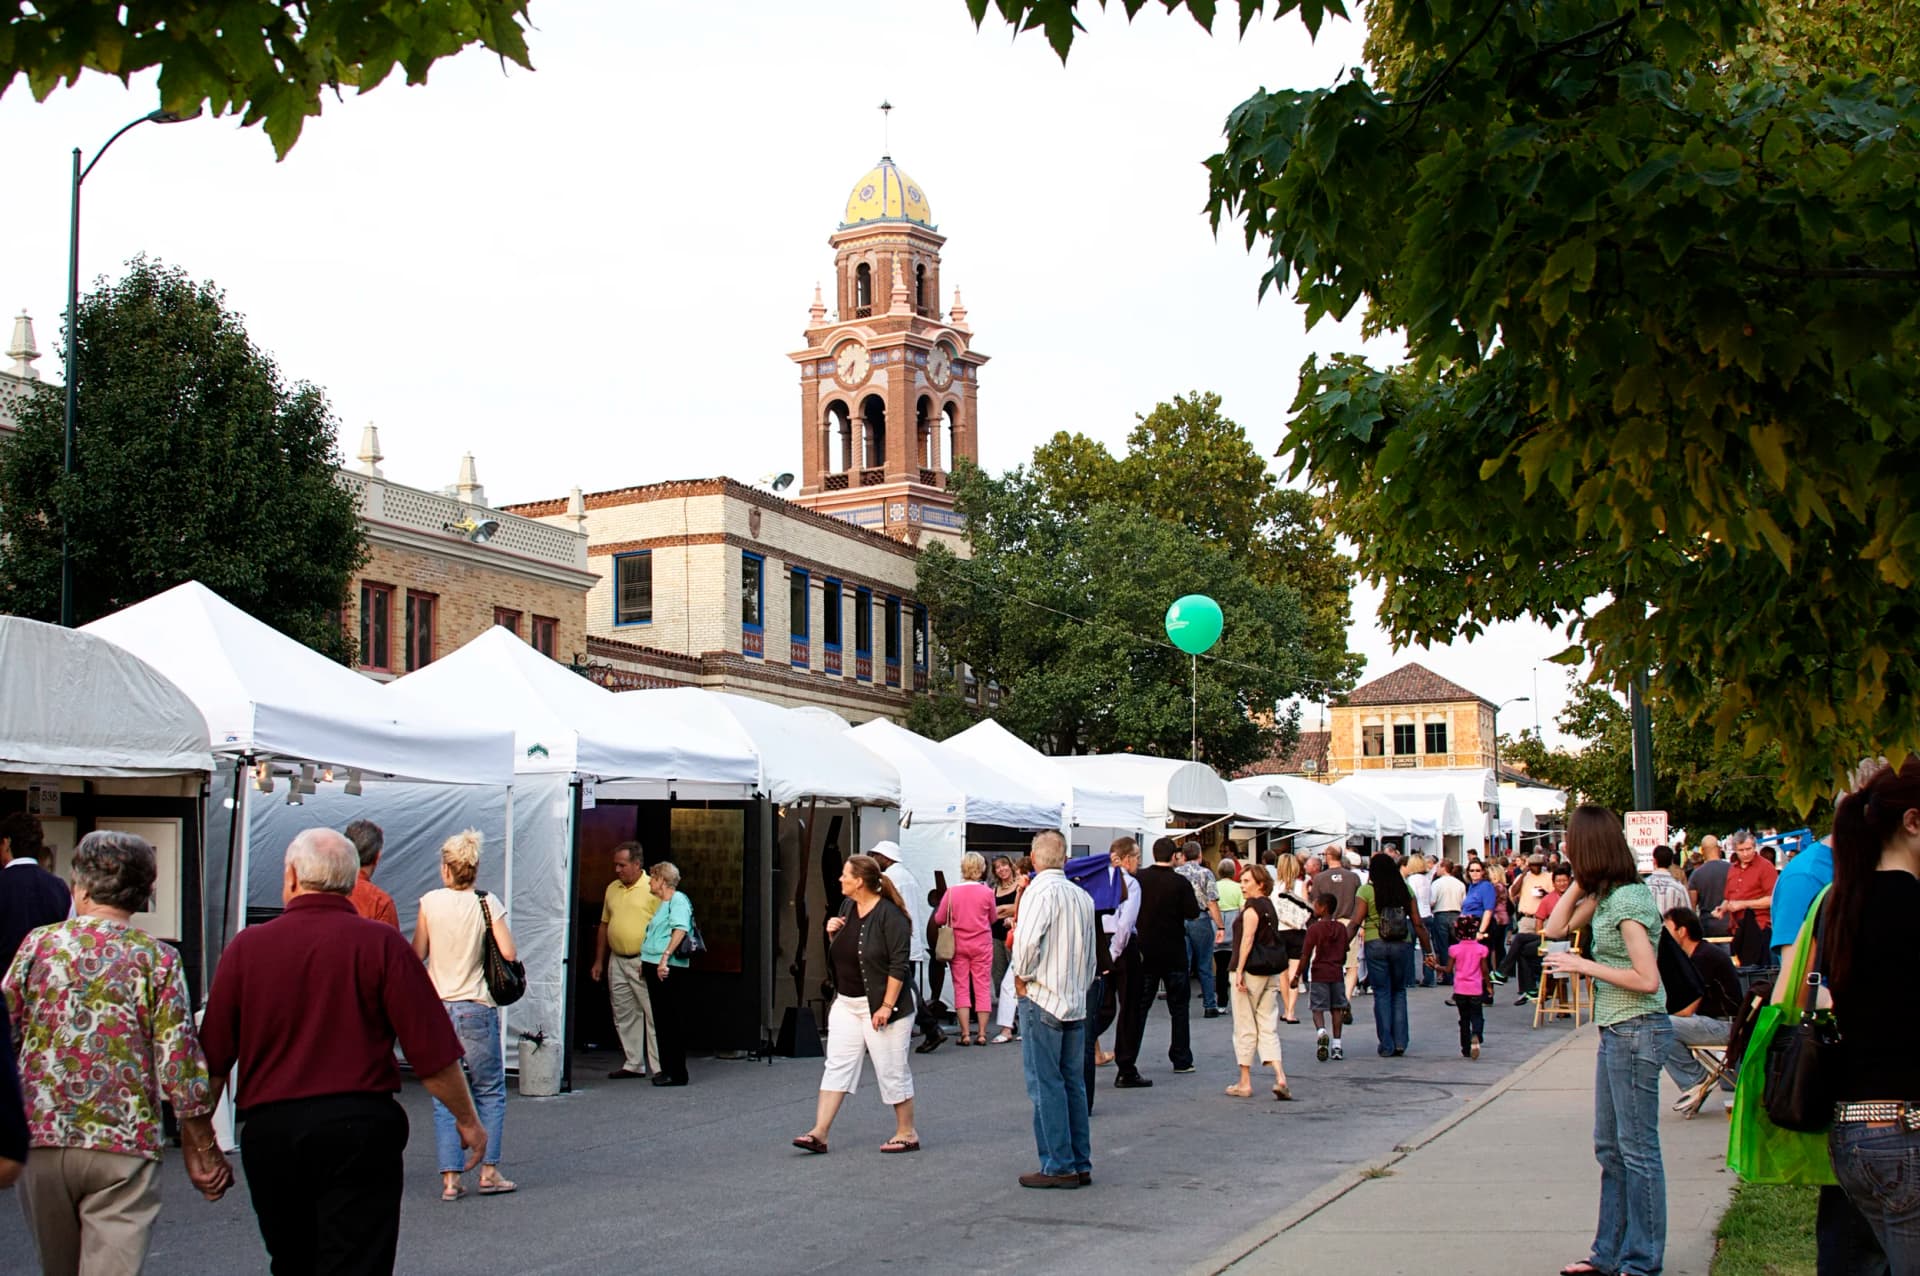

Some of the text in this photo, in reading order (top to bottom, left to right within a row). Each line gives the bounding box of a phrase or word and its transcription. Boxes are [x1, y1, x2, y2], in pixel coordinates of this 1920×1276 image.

[583, 787, 593, 796] 34
[1628, 815, 1663, 825] EMERGENCY
[1639, 827, 1652, 837] NO
